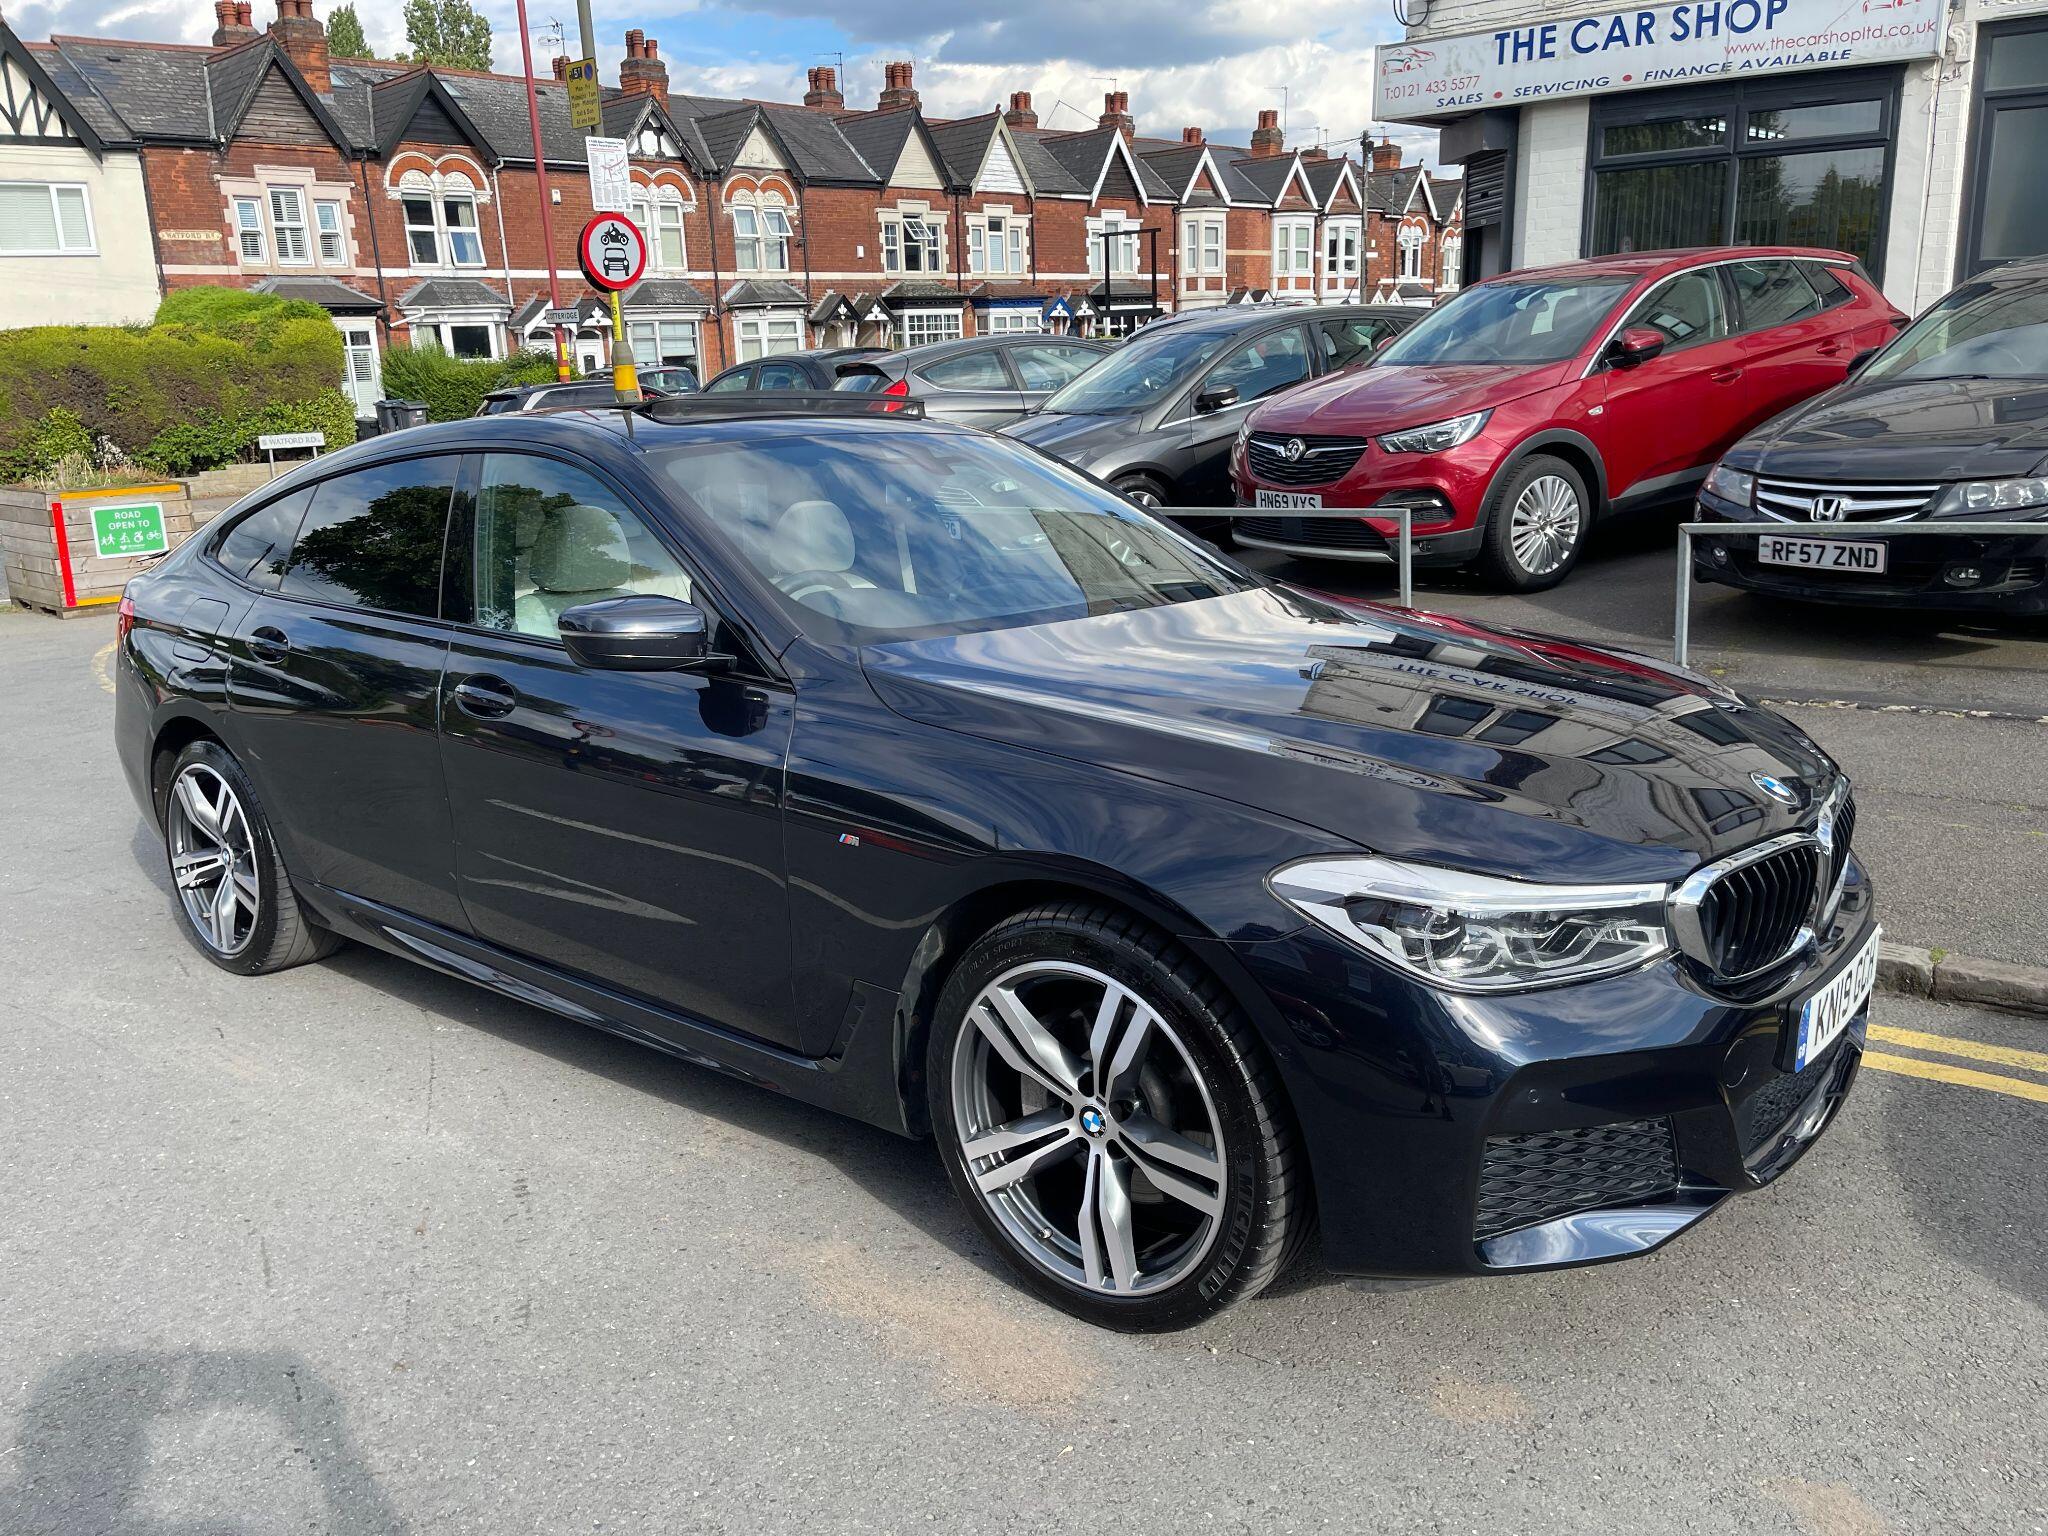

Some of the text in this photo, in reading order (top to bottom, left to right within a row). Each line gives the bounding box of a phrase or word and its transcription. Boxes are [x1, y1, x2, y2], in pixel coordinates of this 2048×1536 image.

[1494, 0, 1788, 65] THE CAR SHOP
[1724, 18, 1937, 56] www.thecarshopltd.co.uk
[1384, 75, 1481, 100] T:0121 433 5577
[1436, 49, 1852, 108] SALES SERVICING FINANCE AVAILABLE
[546, 311, 578, 320] COTTERIDGE
[269, 437, 304, 446] WATFORD
[1259, 491, 1316, 509] HN69 VYS
[108, 519, 150, 530] OPEN TO
[113, 510, 141, 520] ROAD
[1771, 540, 1826, 564] RF57
[1832, 545, 1878, 569] ZND
[1814, 969, 1853, 1047] KN19
